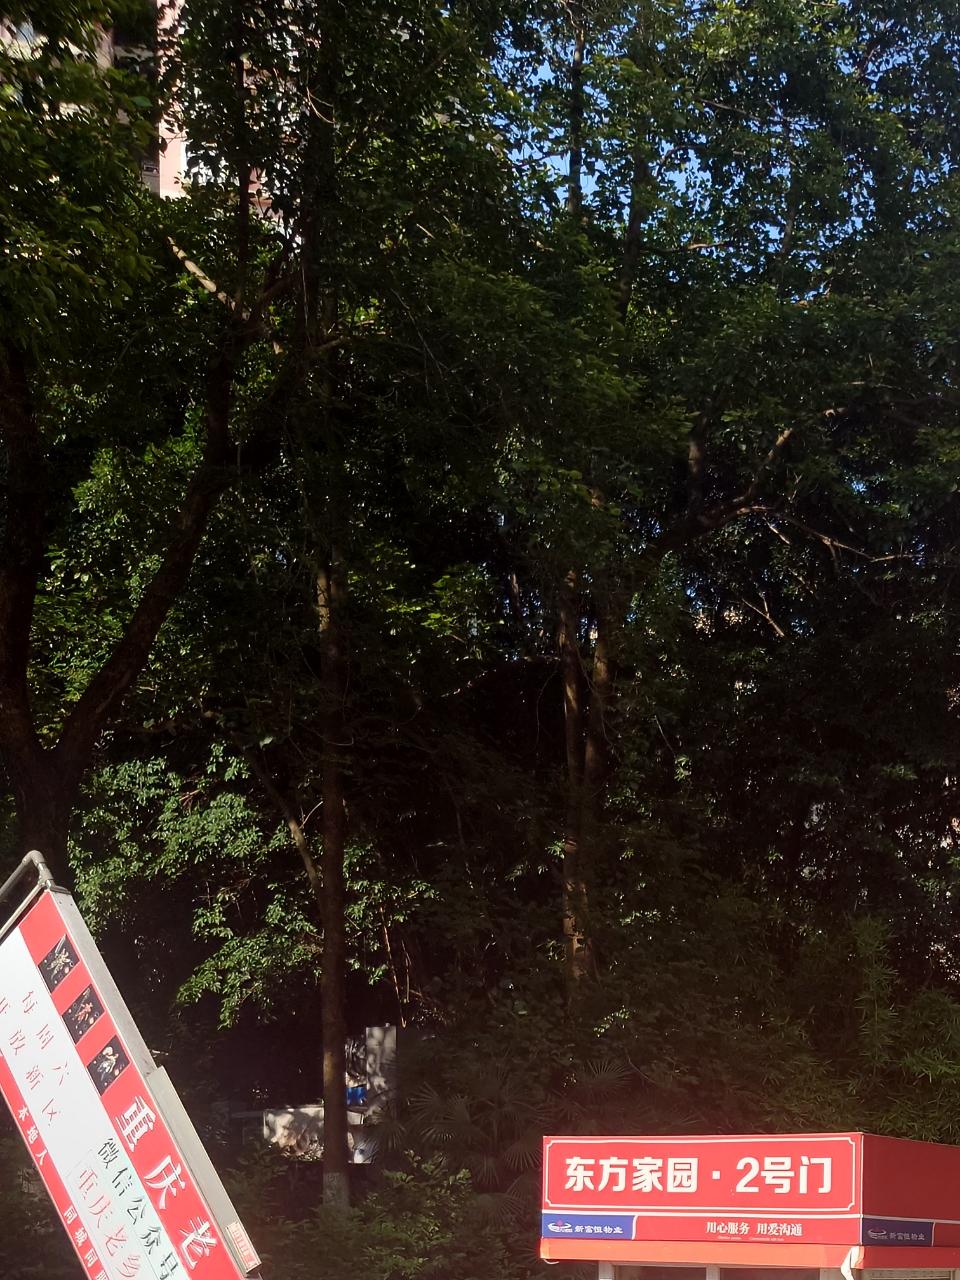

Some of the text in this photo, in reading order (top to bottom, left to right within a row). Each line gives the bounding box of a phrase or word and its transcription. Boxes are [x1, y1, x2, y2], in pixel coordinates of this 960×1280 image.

[21, 990, 70, 1087] 每周六
[17, 1104, 49, 1166] 本地人
[705, 1222, 803, 1236] 用心服务 用爱沟通
